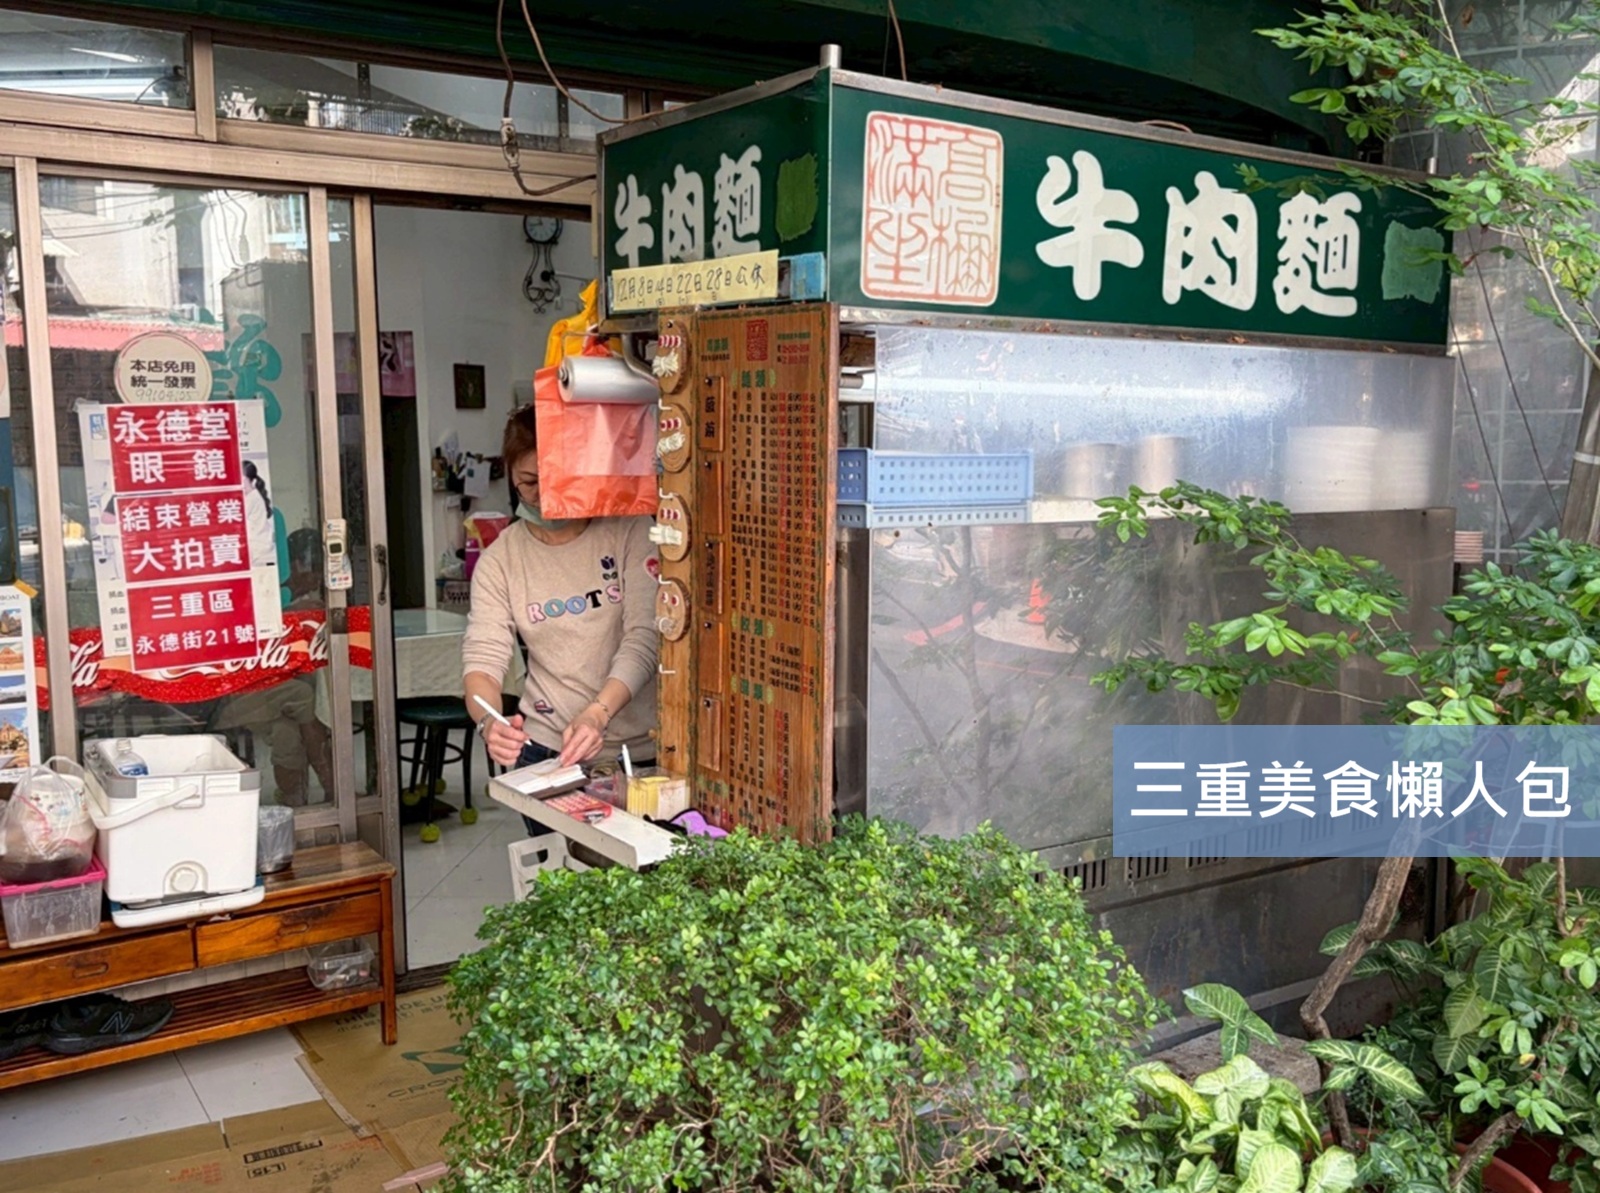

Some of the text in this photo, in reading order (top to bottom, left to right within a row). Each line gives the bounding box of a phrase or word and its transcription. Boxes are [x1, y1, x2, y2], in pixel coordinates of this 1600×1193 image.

[615, 145, 762, 266] 牛肉麵
[1035, 150, 1362, 318] 牛肉麵
[130, 359, 196, 373] 本店免用
[130, 375, 196, 389] 統一發票
[113, 408, 231, 445] 永德堂
[130, 449, 227, 483] 眼鏡
[122, 499, 243, 532] 結束營業
[131, 534, 242, 574] 大拍賣
[151, 589, 234, 619] 三重區
[527, 584, 622, 624] ROOTS
[136, 624, 255, 655] 永德街21號
